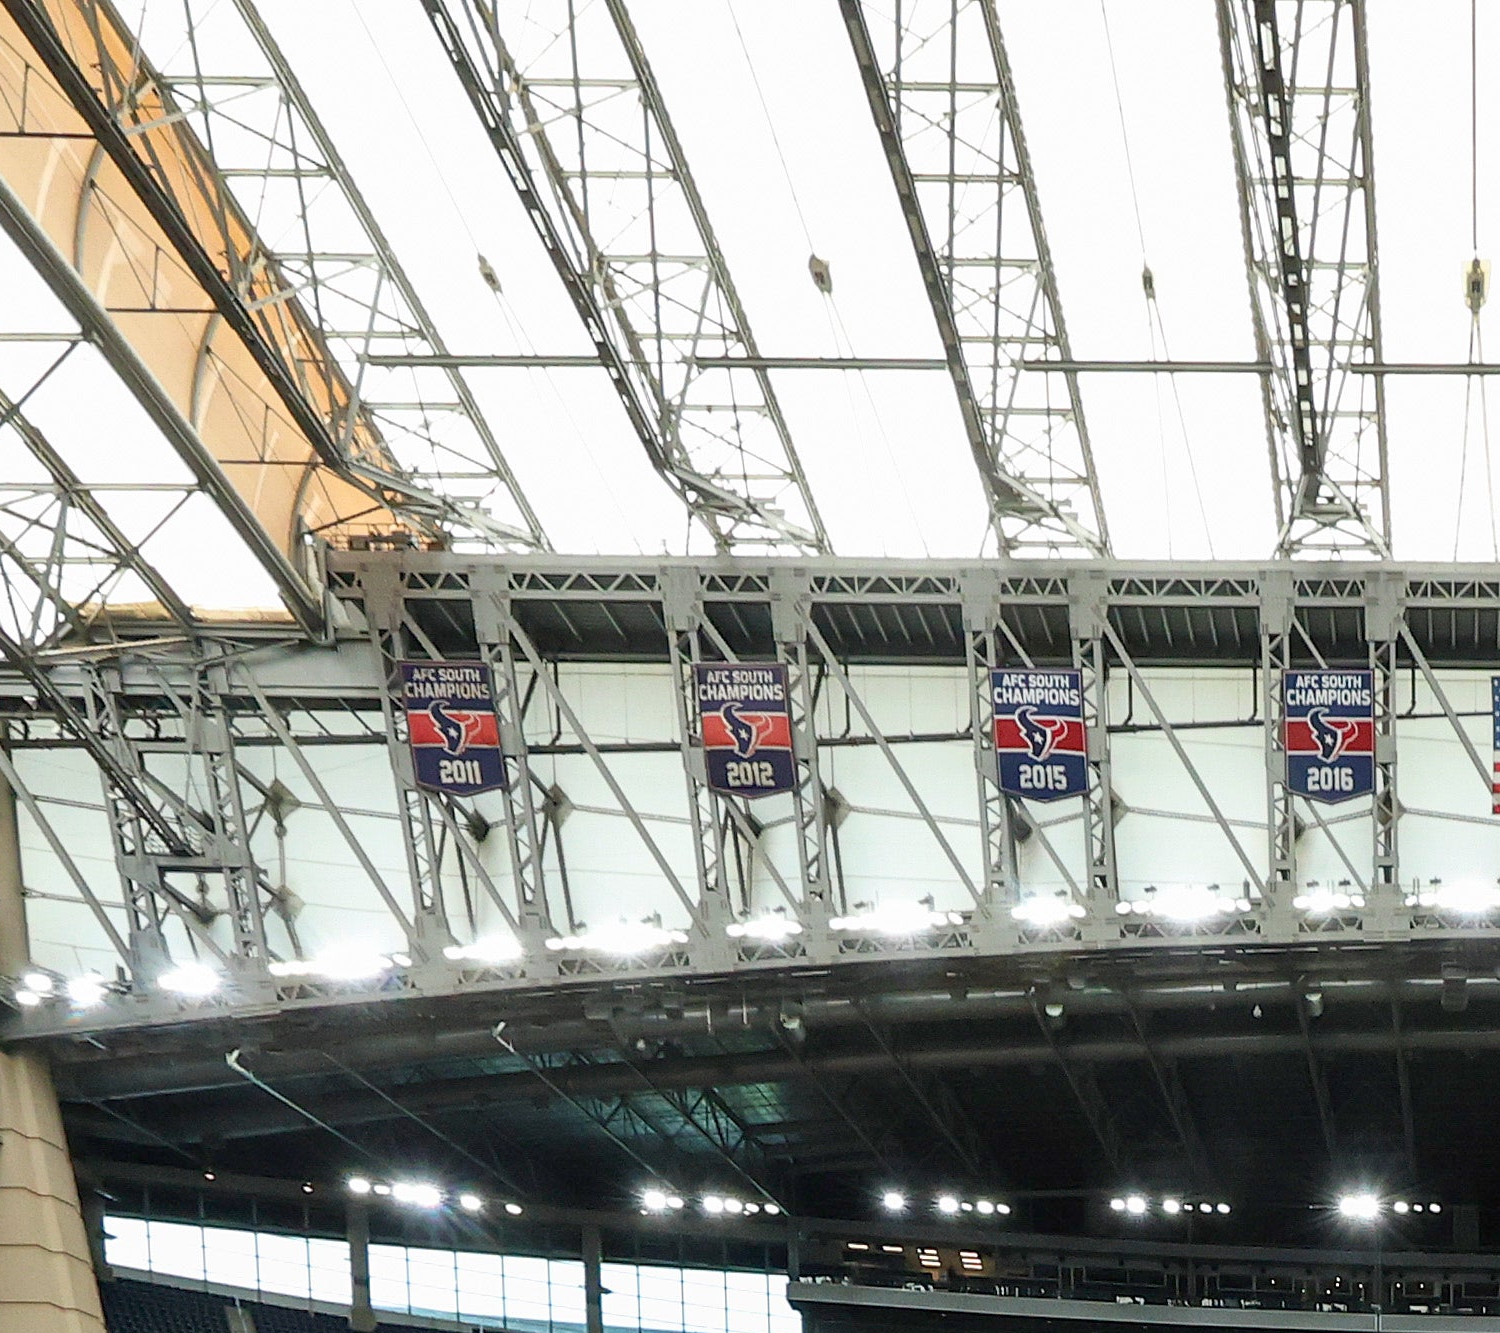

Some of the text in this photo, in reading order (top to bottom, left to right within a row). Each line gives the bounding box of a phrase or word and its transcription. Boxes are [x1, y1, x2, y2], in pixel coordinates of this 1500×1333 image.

[412, 668, 480, 682] AFC SOUTH
[706, 670, 773, 683] AFC SOUTH
[1002, 674, 1069, 688] AFC SOUTH
[1296, 676, 1362, 688] AFC SOUTH
[405, 682, 492, 699] CHAMPIONS
[700, 682, 784, 700] CHAMPIONS
[994, 688, 1080, 705] CHAMPIONS
[1286, 689, 1371, 706] CHAMPIONS
[440, 760, 482, 784] 2011
[726, 761, 775, 786] 2012
[1019, 764, 1066, 790] 2015
[1307, 767, 1354, 791] 2016
